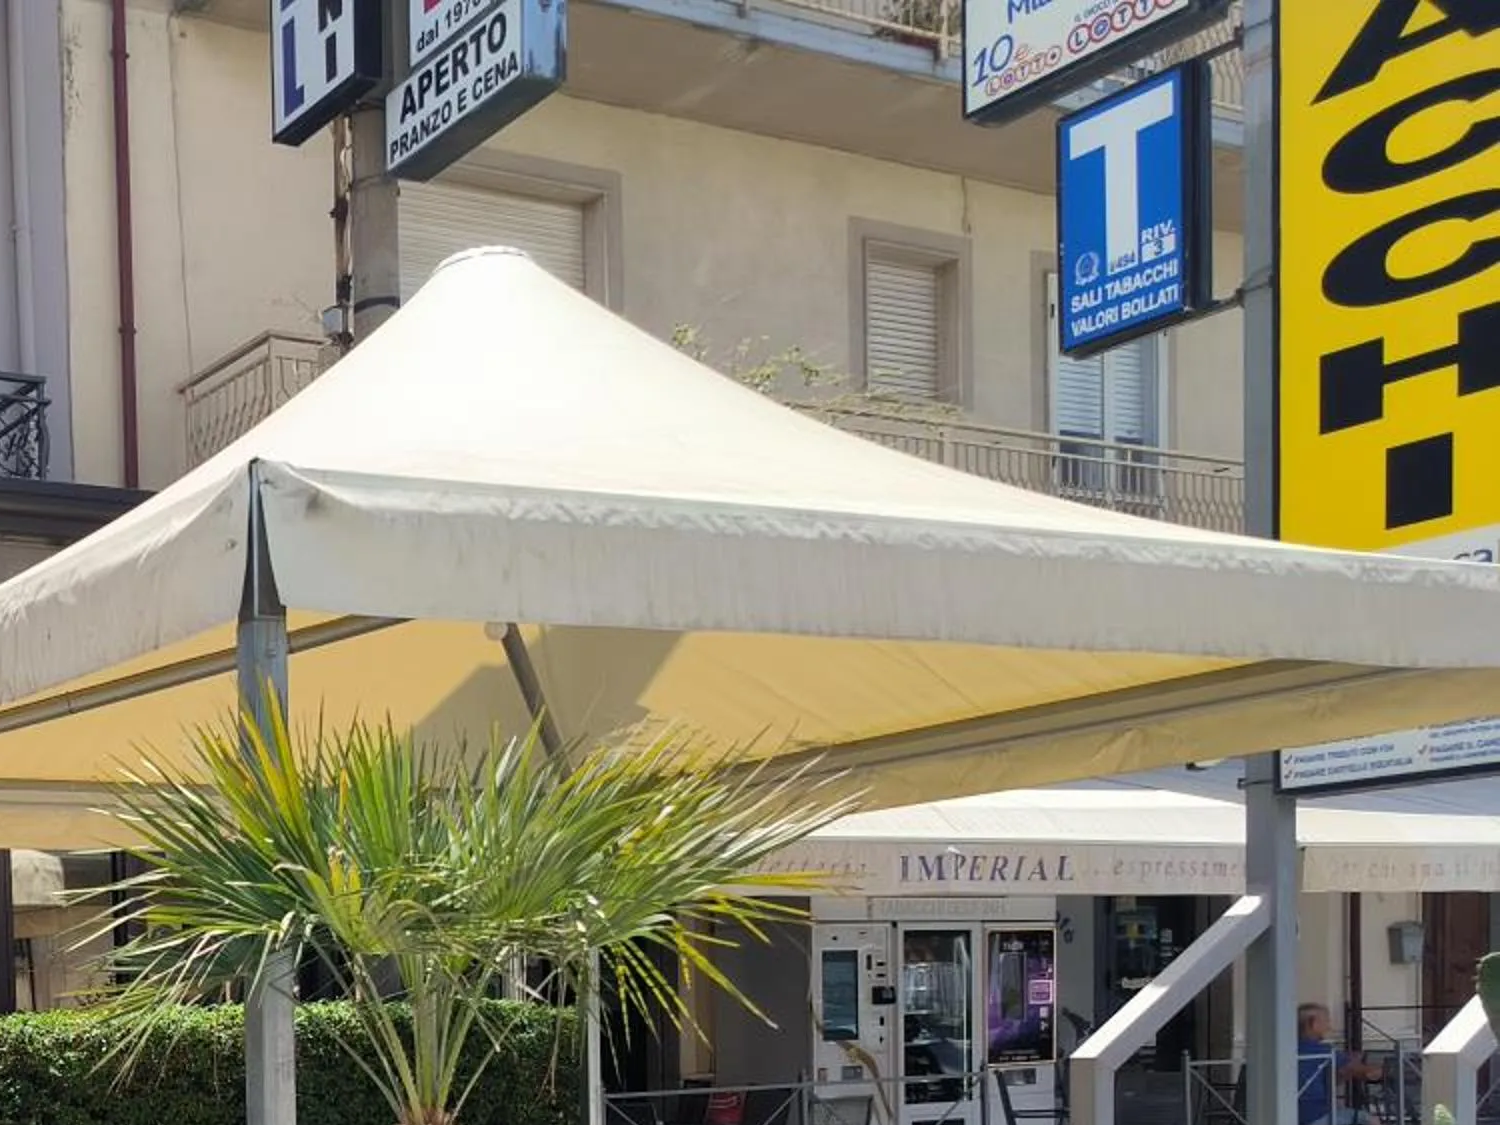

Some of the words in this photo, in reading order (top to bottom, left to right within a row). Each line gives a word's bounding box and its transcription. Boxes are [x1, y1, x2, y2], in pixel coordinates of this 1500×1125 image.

[416, 20, 439, 52] dal
[400, 12, 507, 124] APERTO
[389, 102, 452, 165] PRANZO
[457, 89, 467, 113] E
[472, 52, 518, 100] CENA
[1069, 80, 1174, 274] T
[1071, 287, 1102, 314] SALI
[1105, 258, 1179, 300] TABACCHI
[1071, 305, 1118, 337] VALORI
[1121, 283, 1179, 320] BOLLATI
[900, 855, 1075, 882] IMPERIAL
